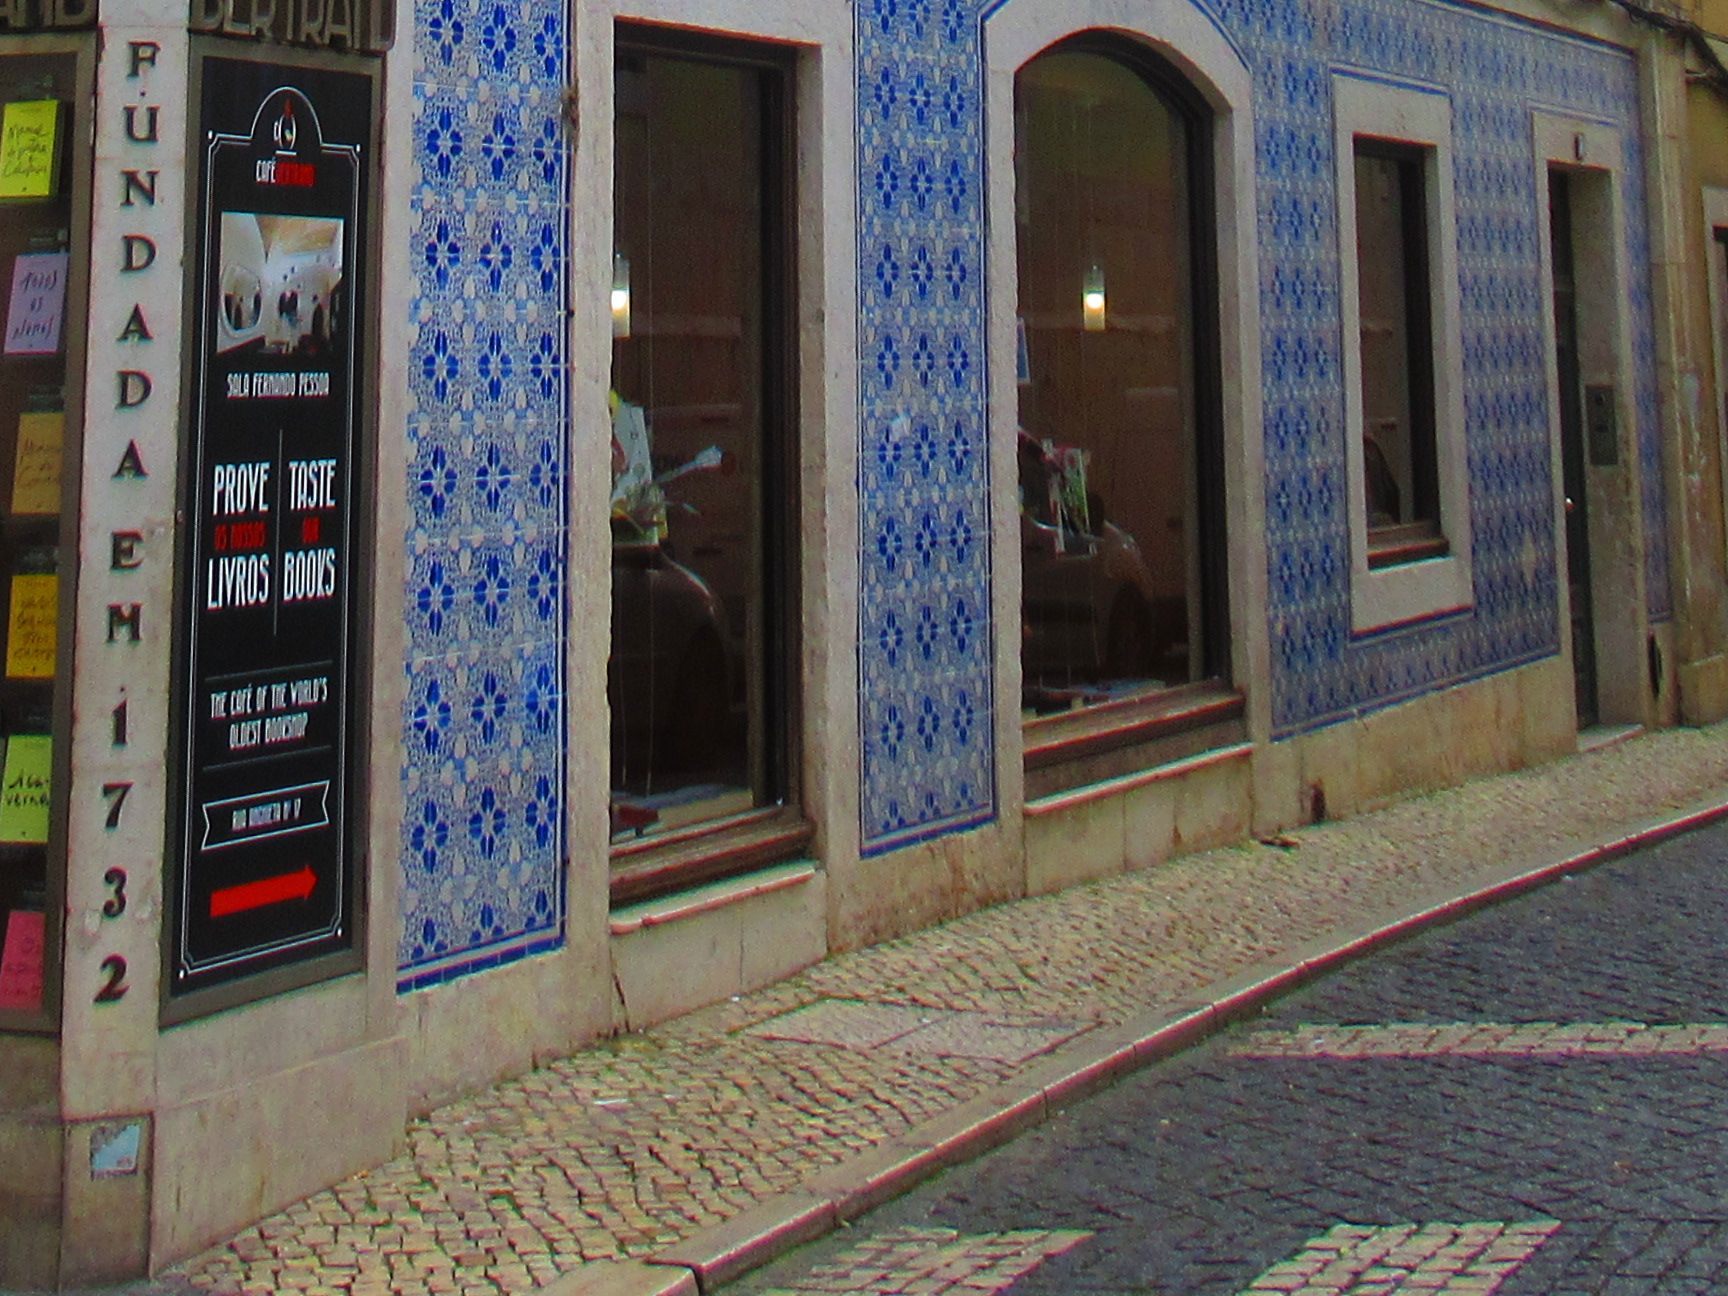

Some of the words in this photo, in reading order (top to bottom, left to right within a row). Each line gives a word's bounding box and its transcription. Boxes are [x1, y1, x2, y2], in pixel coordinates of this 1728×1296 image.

[227, 372, 249, 397] SALA
[299, 372, 329, 396] PESSOA
[213, 462, 270, 515] PROVE
[288, 458, 337, 510] TASTE
[207, 553, 270, 609] LIVROS
[283, 548, 336, 602] BOOKS
[211, 692, 227, 718] THE
[230, 683, 253, 714] CAFÉ
[256, 685, 268, 711] OF
[271, 683, 287, 709] THE
[290, 677, 328, 706] WORLD'S
[229, 719, 262, 749] OLDEST
[265, 712, 308, 743] BOOKSHOP
